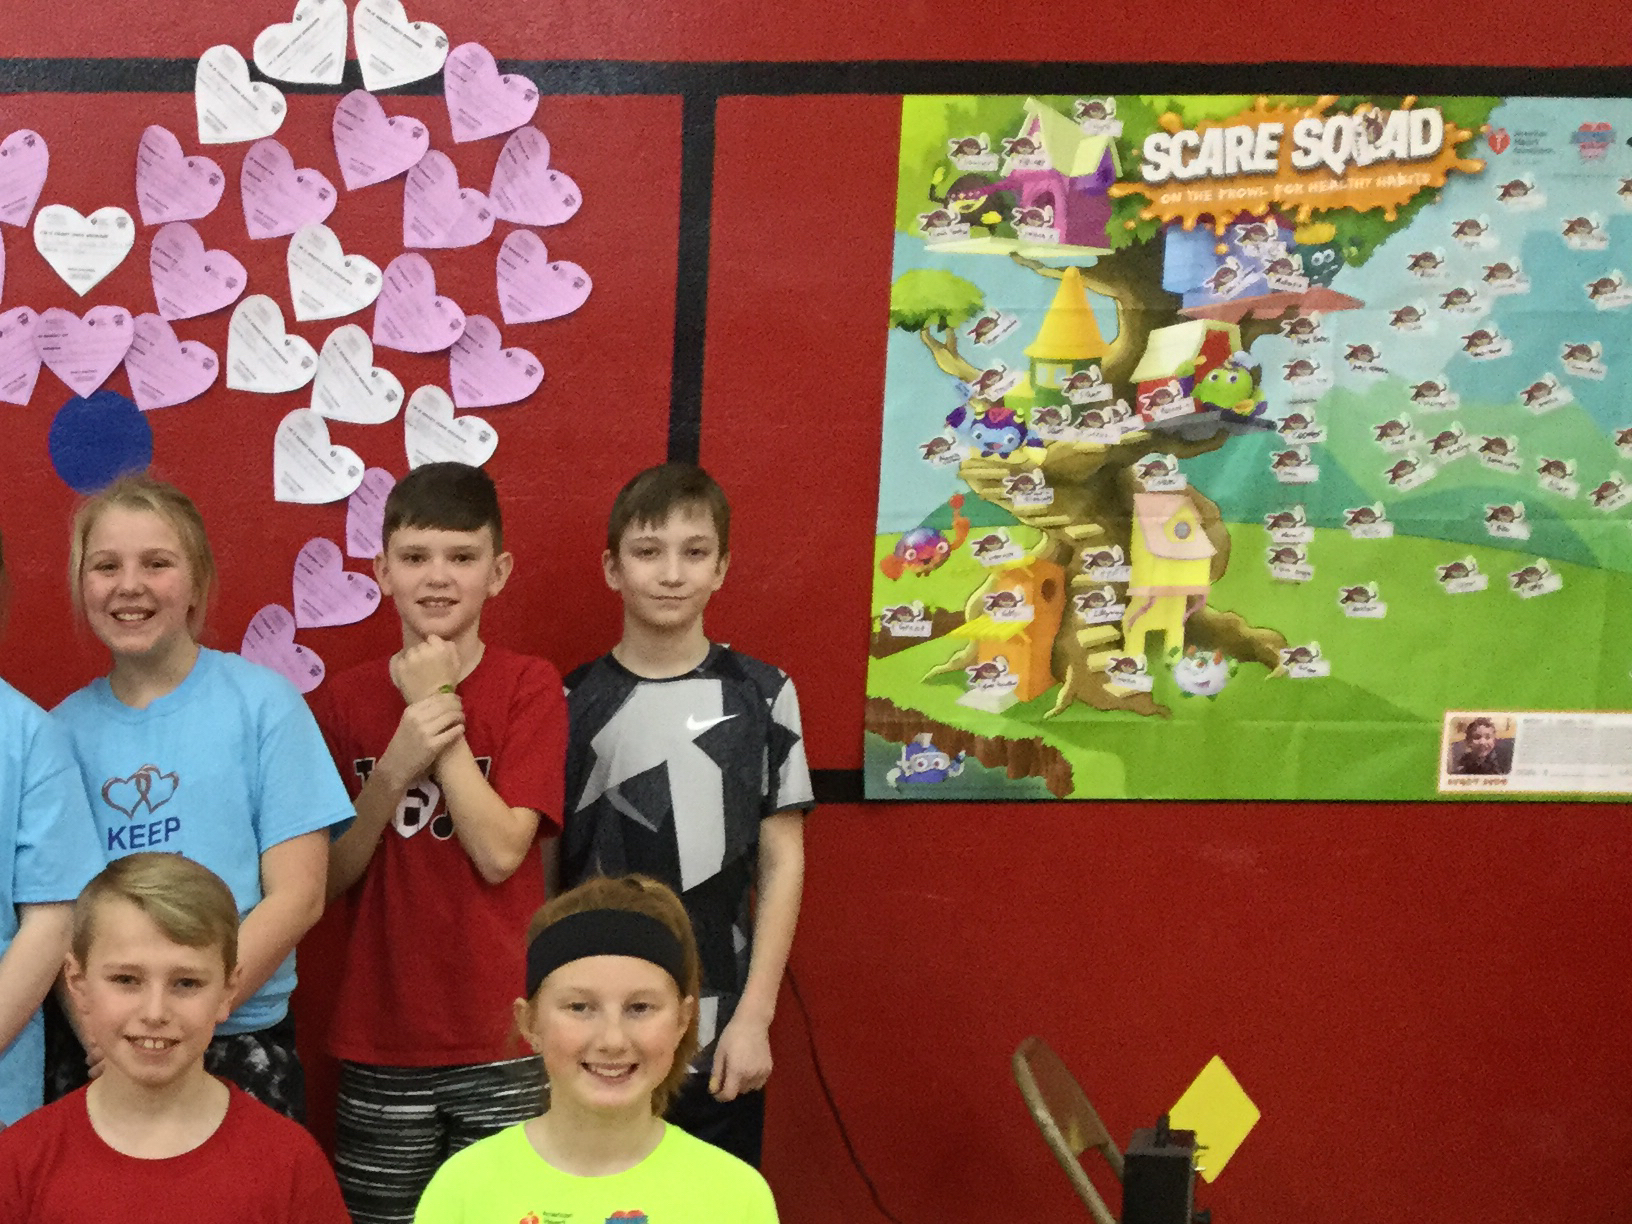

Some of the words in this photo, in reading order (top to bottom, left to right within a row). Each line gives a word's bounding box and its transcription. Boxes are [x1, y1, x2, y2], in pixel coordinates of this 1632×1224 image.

[1141, 121, 1284, 183] SCARE
[1291, 107, 1444, 179] SQAD
[107, 815, 182, 852] KEEP
